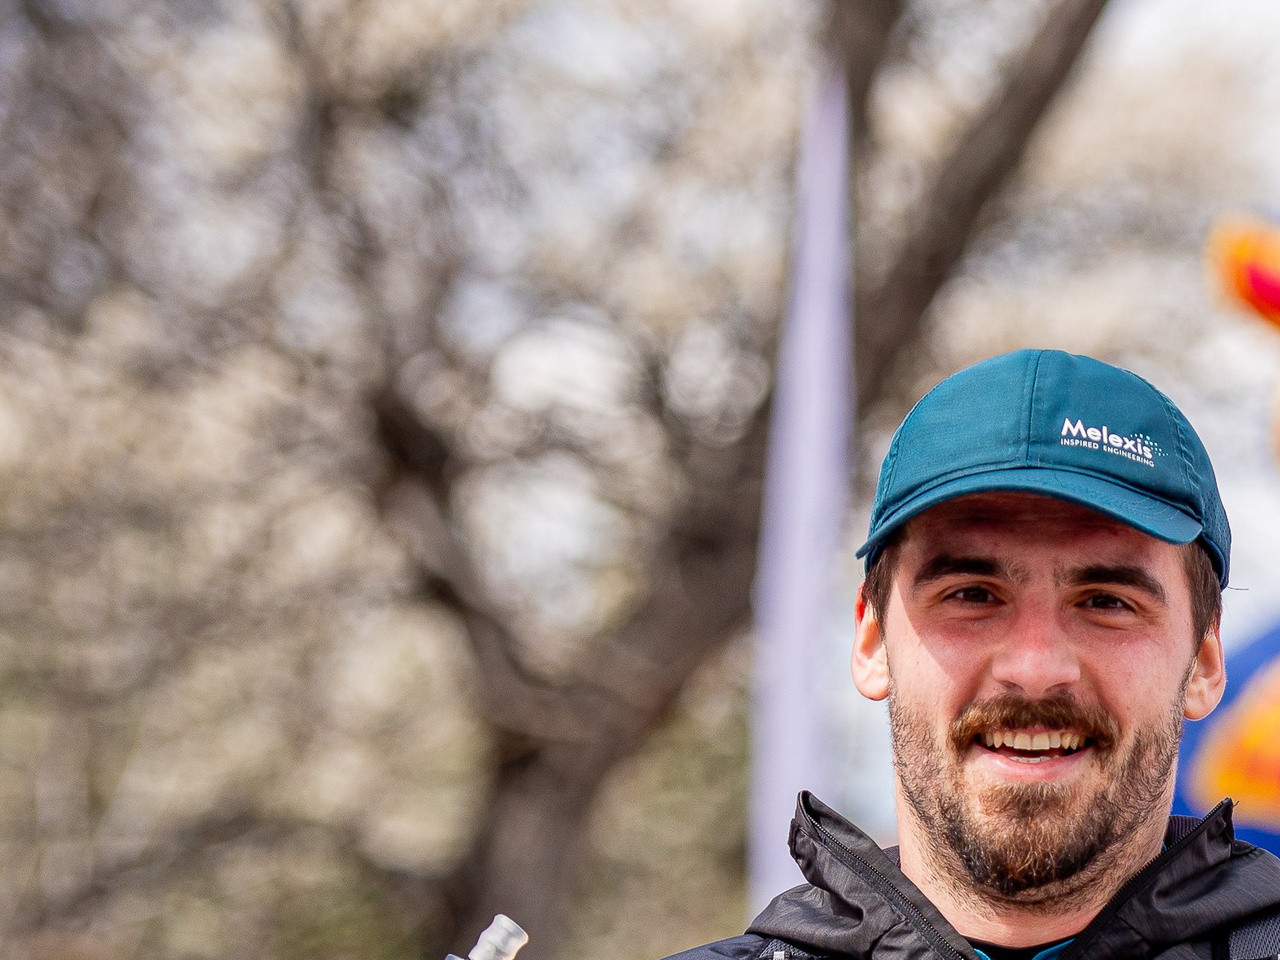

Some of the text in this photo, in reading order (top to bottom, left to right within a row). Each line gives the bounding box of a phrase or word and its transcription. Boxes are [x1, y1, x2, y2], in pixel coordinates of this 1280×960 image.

[1060, 438, 1155, 467] INSPIRED ENGINEERING
[1061, 417, 1153, 459] Melexis
